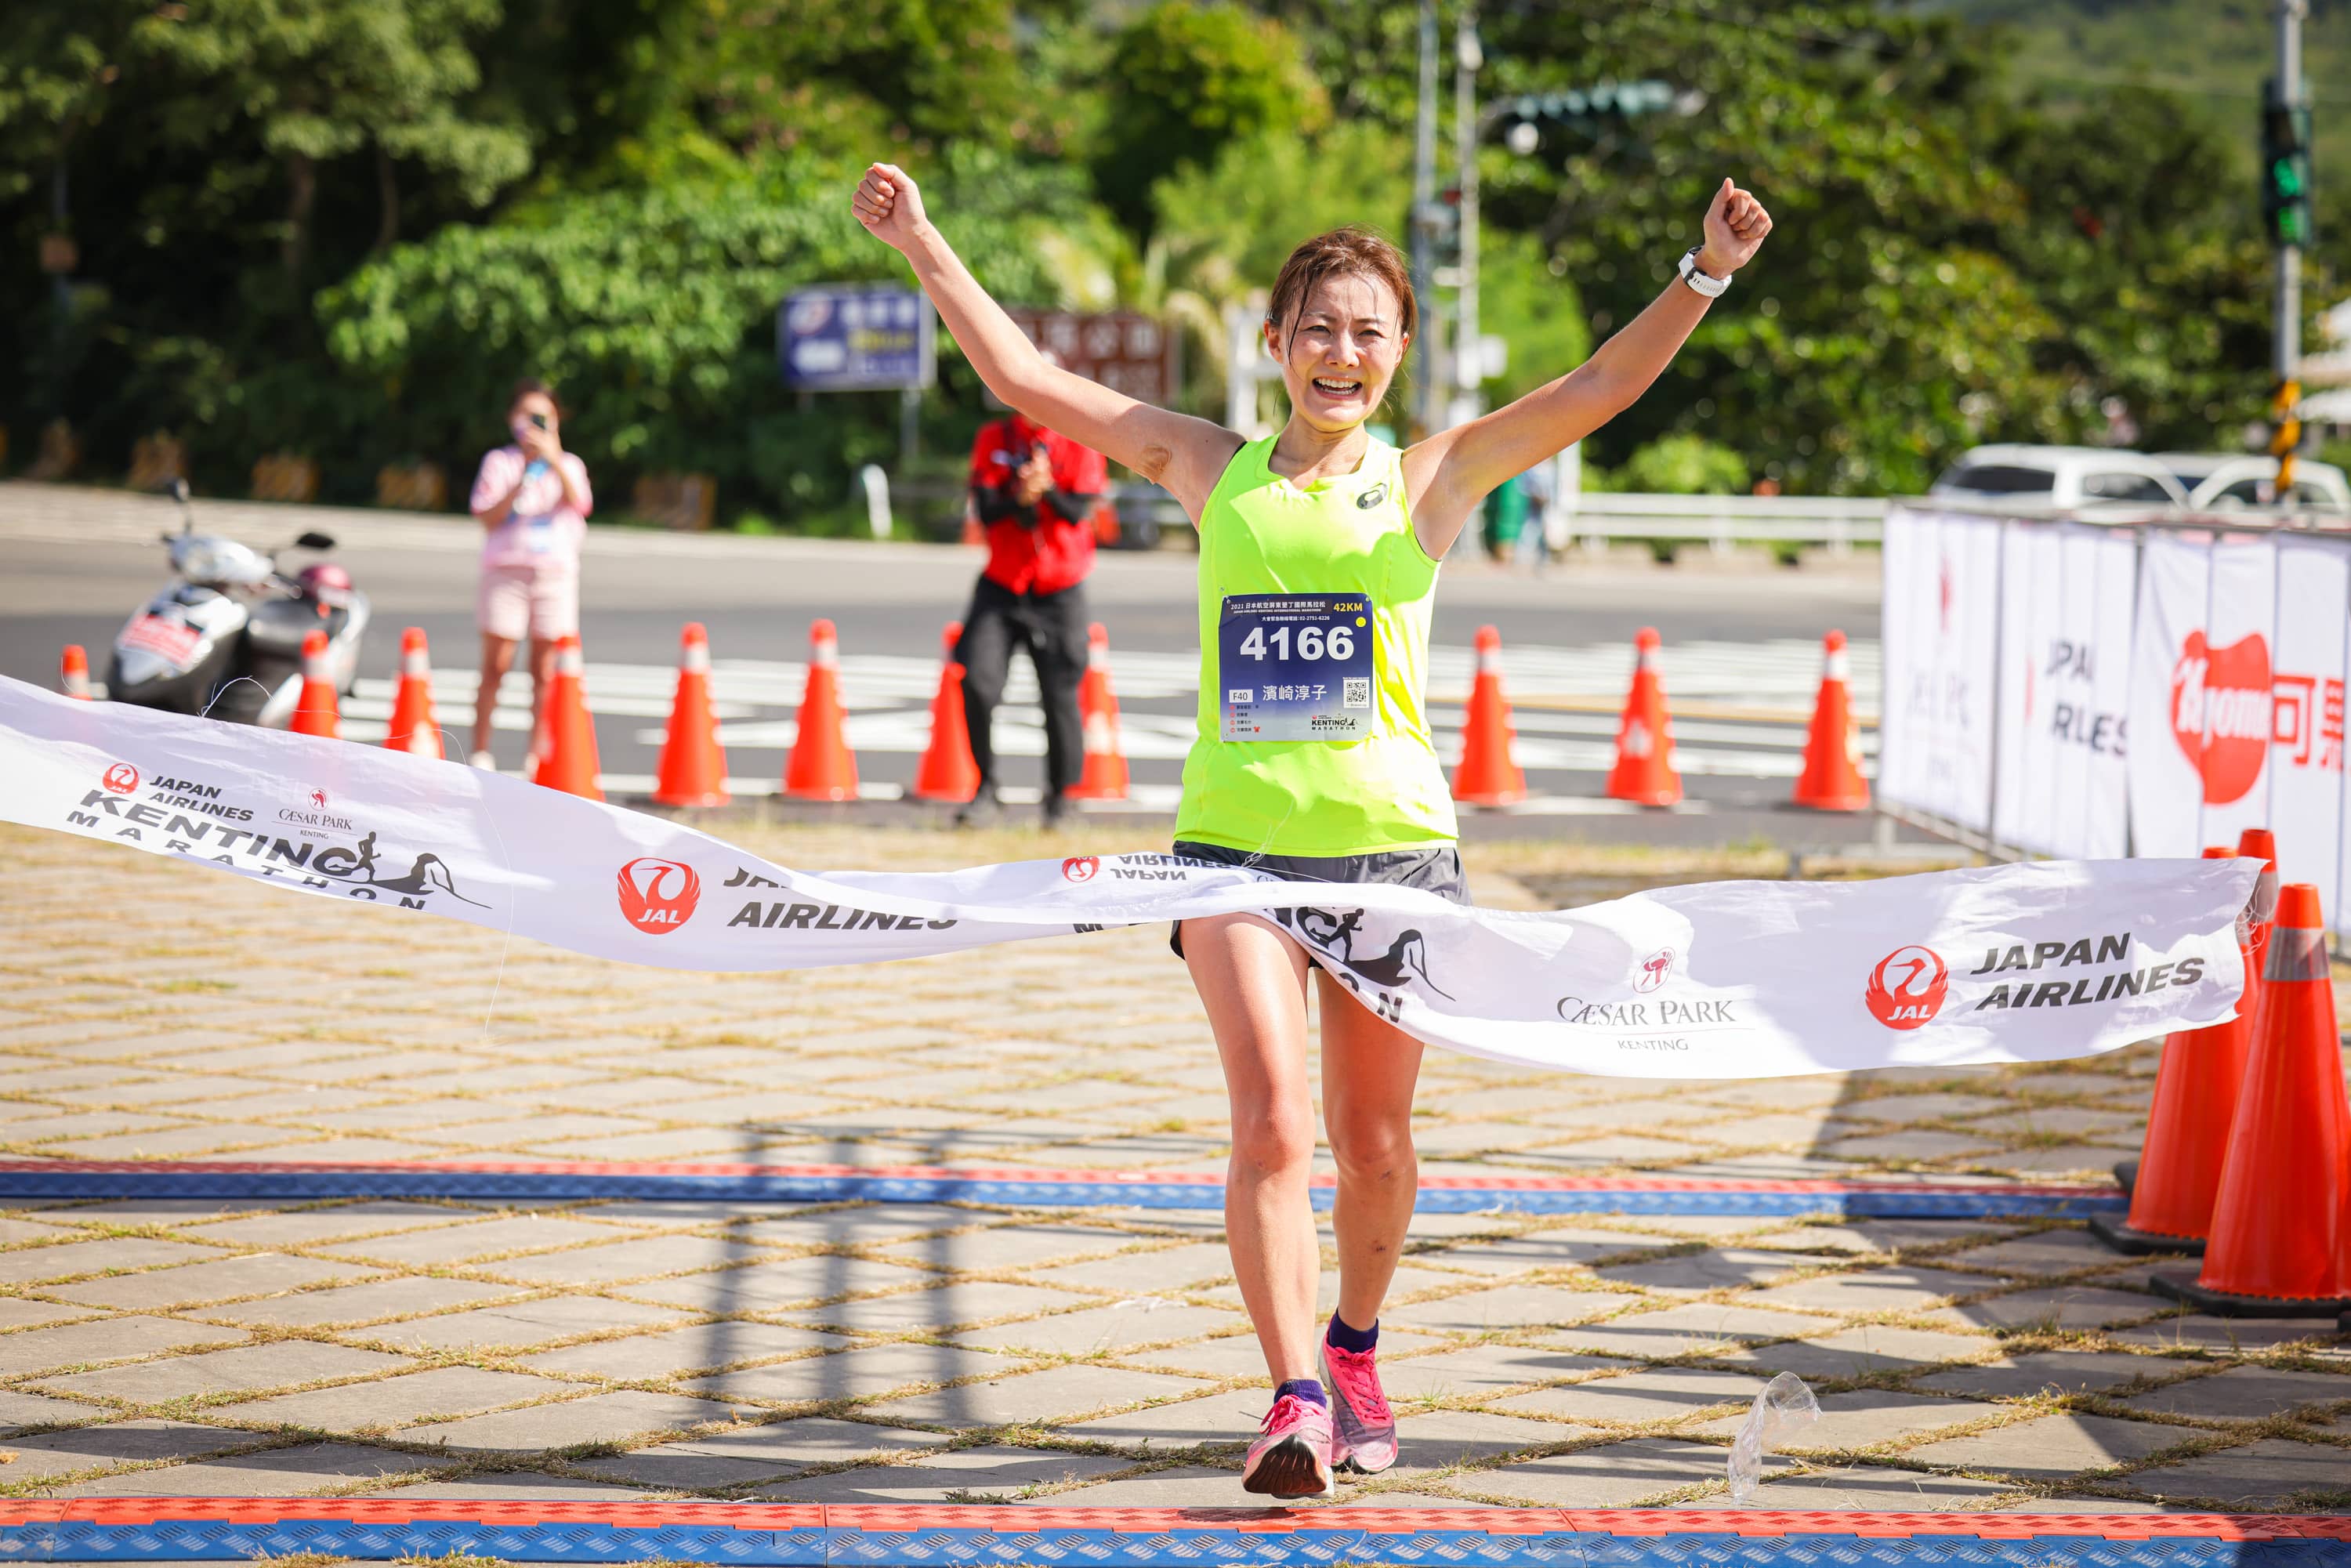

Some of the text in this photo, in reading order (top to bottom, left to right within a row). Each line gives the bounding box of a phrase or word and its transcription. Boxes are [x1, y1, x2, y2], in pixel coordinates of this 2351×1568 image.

[1333, 603, 1363, 612] 42KM
[1240, 626, 1354, 661] 4166
[1233, 692, 1248, 701] F40
[1262, 684, 1327, 701] 濱崎淳子
[109, 785, 129, 794] JAL
[149, 776, 222, 798] JAPAN
[148, 792, 255, 821] AIRLINES
[322, 814, 352, 831] PARK
[80, 789, 357, 877] KENTING
[300, 829, 329, 840] KENTING
[66, 810, 426, 910] MARATHON
[637, 908, 680, 923] JAL
[1969, 932, 2131, 975] JAPAN
[1974, 957, 2204, 1011] AIRLINES
[1658, 999, 1737, 1025] PARK
[1886, 1004, 1933, 1020] JAL
[1617, 1038, 1689, 1051] KENTING
